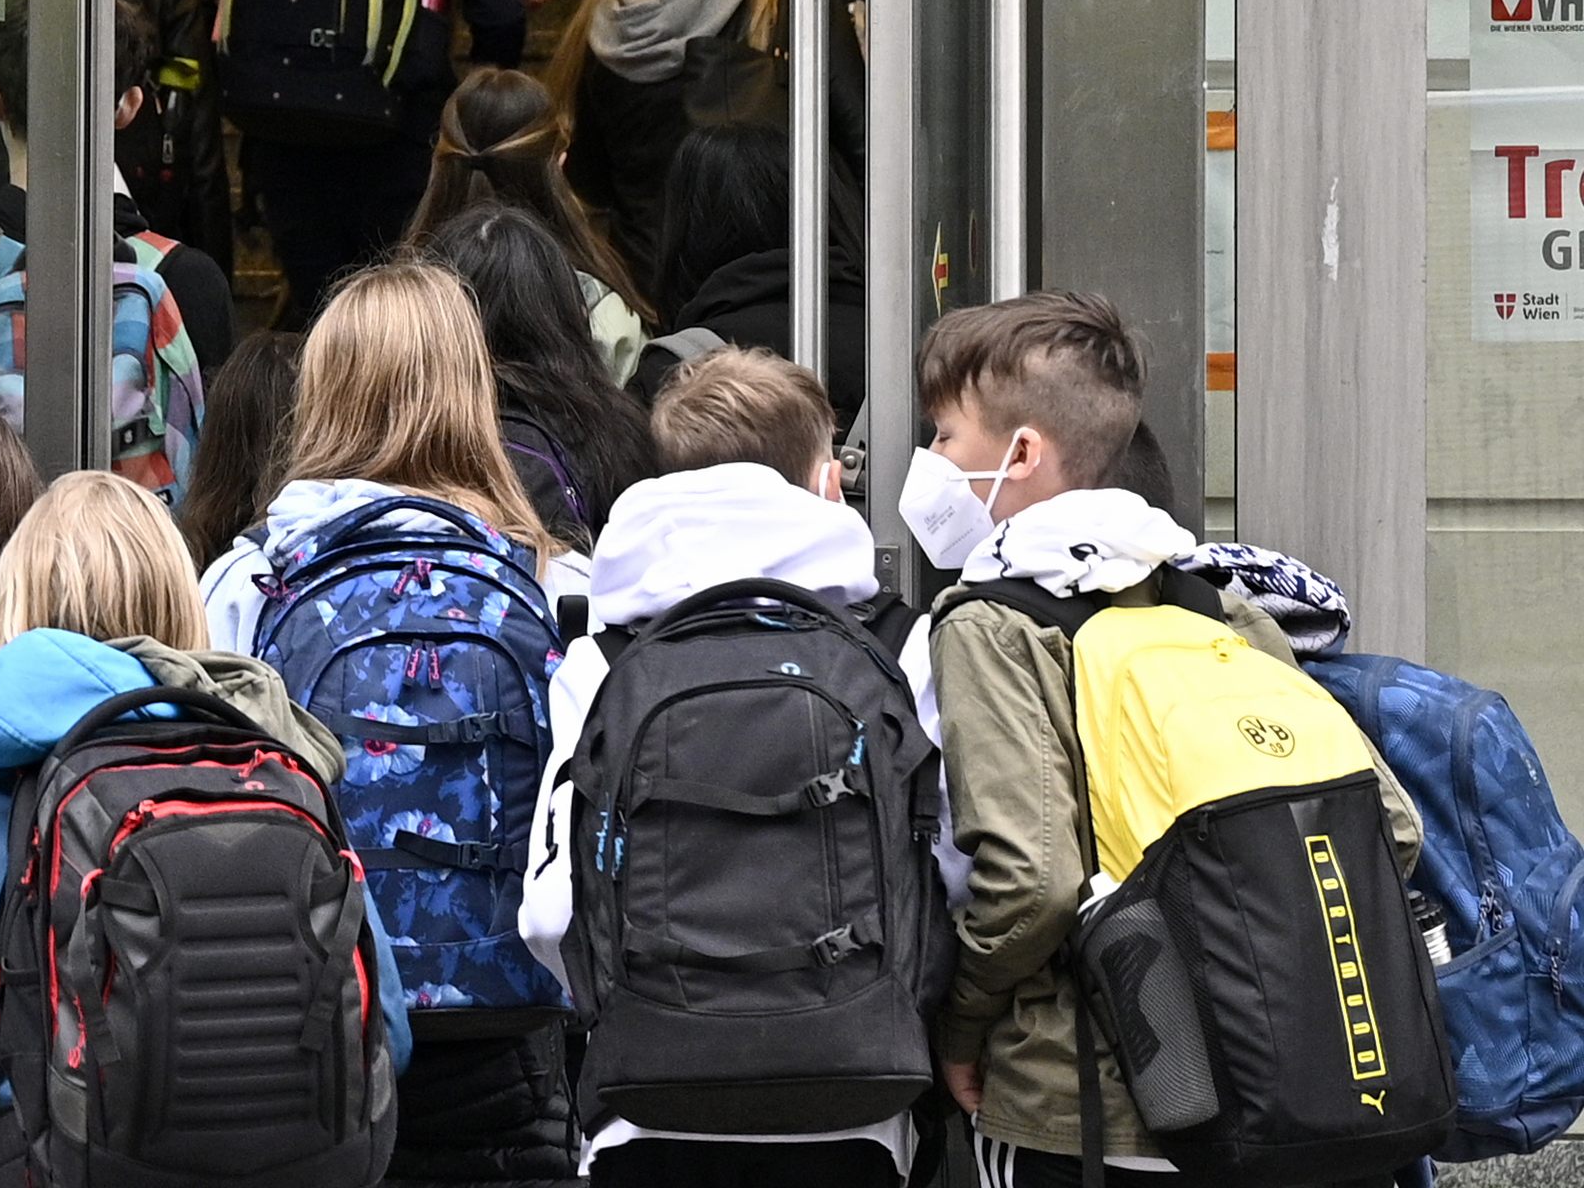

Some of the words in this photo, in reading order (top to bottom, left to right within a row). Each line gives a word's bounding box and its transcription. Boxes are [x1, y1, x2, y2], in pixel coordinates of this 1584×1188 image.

[1495, 145, 1584, 218] Tr
[1542, 230, 1584, 270] G
[1523, 293, 1559, 305] Stadt
[1523, 308, 1559, 320] Wien
[1313, 851, 1376, 1063] DORTMUND
